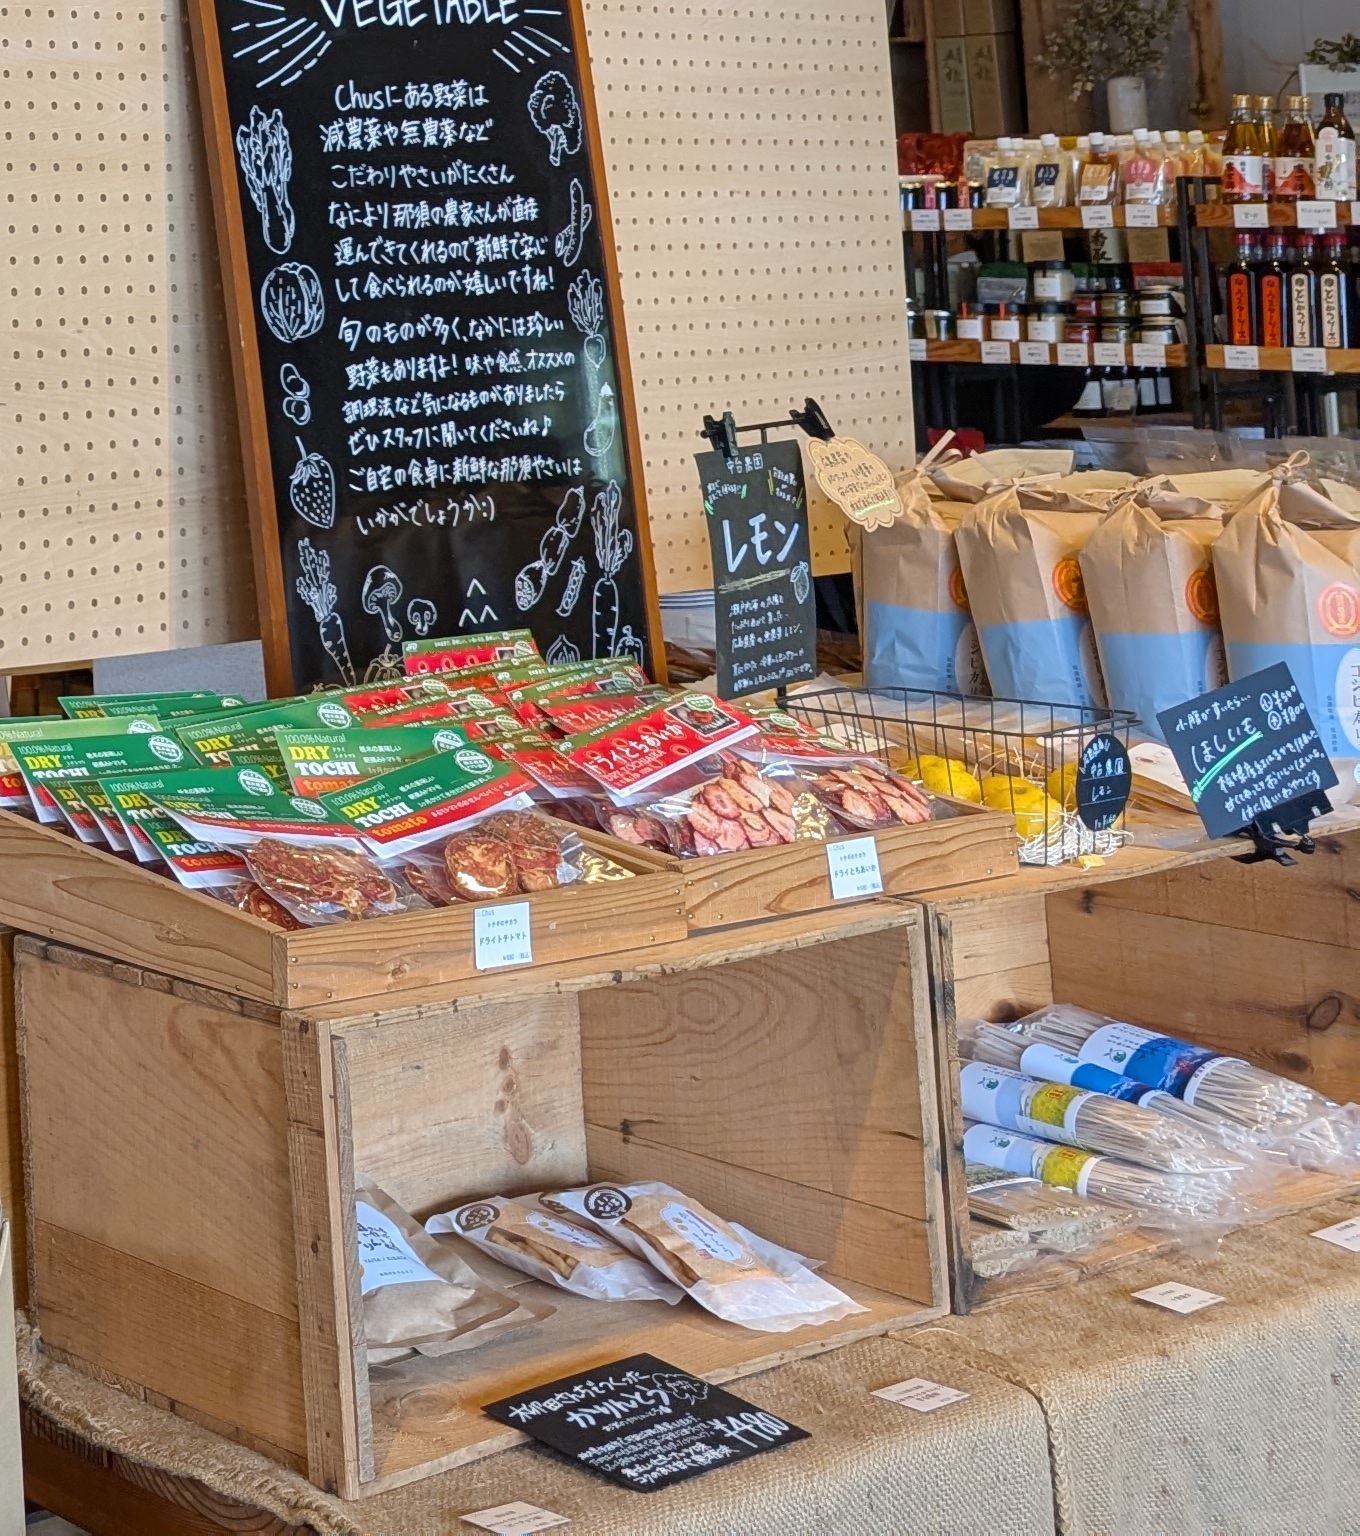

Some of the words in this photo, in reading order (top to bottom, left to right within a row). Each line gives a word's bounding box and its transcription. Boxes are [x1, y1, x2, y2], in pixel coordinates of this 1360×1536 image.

[318, 117, 493, 154] 減農薬や無農薬など
[331, 157, 515, 191] こだわりやさいがたくさん
[722, 513, 800, 573] レモン
[193, 734, 234, 752] DRY
[288, 746, 331, 762] DRY
[1190, 717, 1257, 774] ほしいも
[26, 755, 63, 770] DRY
[294, 760, 360, 777] TOCHI
[339, 796, 381, 819] DRY
[354, 802, 414, 829] TOCHI
[371, 815, 429, 839] tomato
[566, 1384, 671, 1429] かりんとう
[713, 1410, 790, 1449] ¥480
